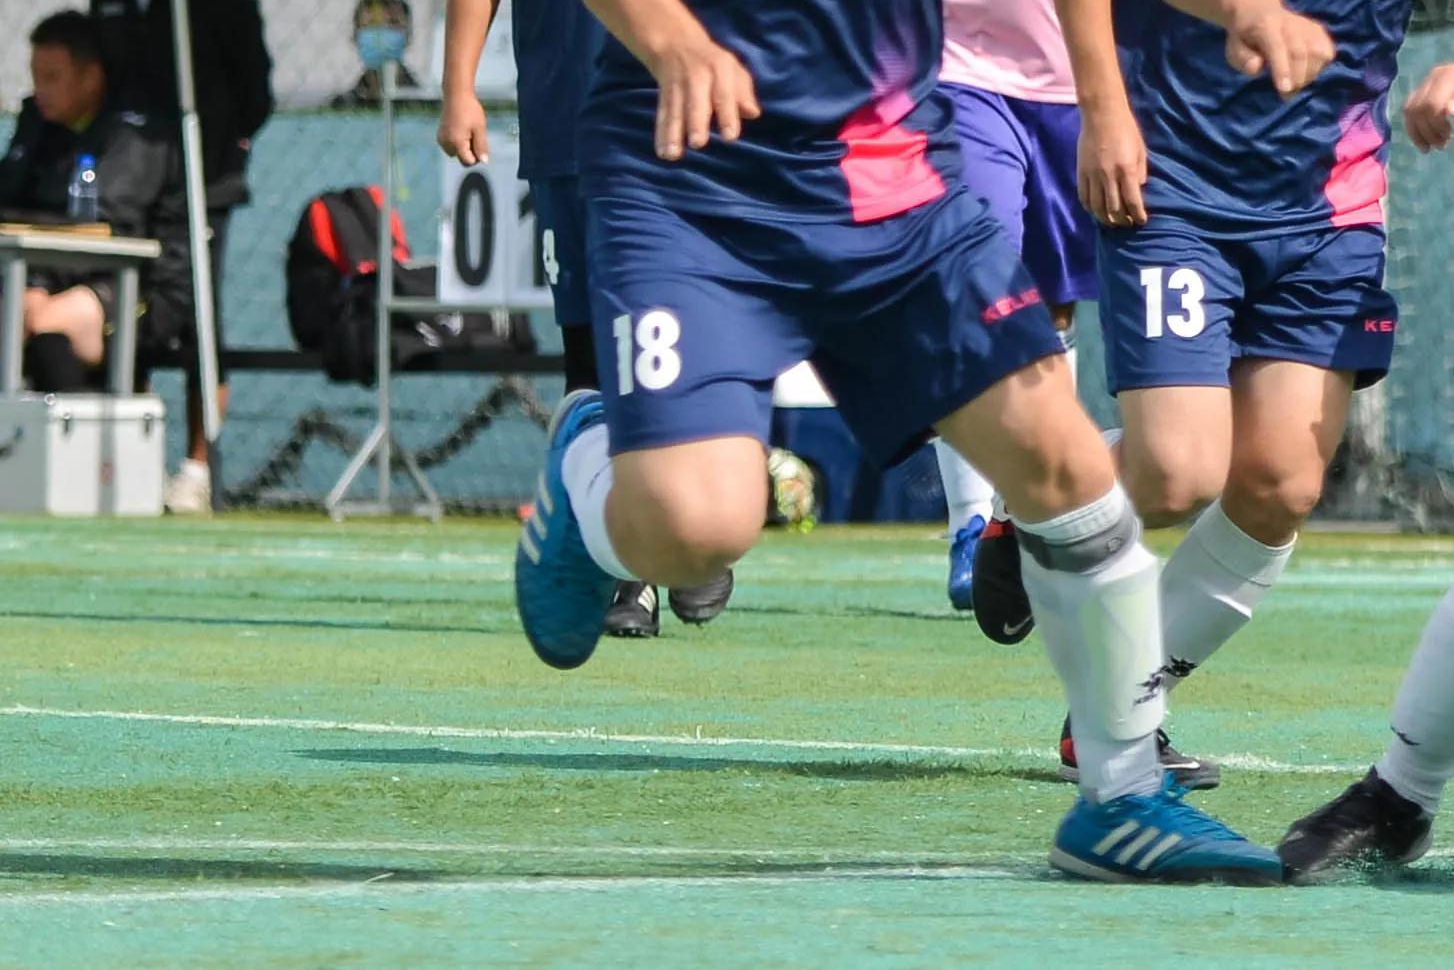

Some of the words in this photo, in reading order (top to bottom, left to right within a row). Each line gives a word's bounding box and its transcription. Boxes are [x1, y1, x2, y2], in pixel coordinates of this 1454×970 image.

[1140, 267, 1206, 338] 13
[1364, 318, 1398, 333] KE
[612, 310, 682, 396] 18
